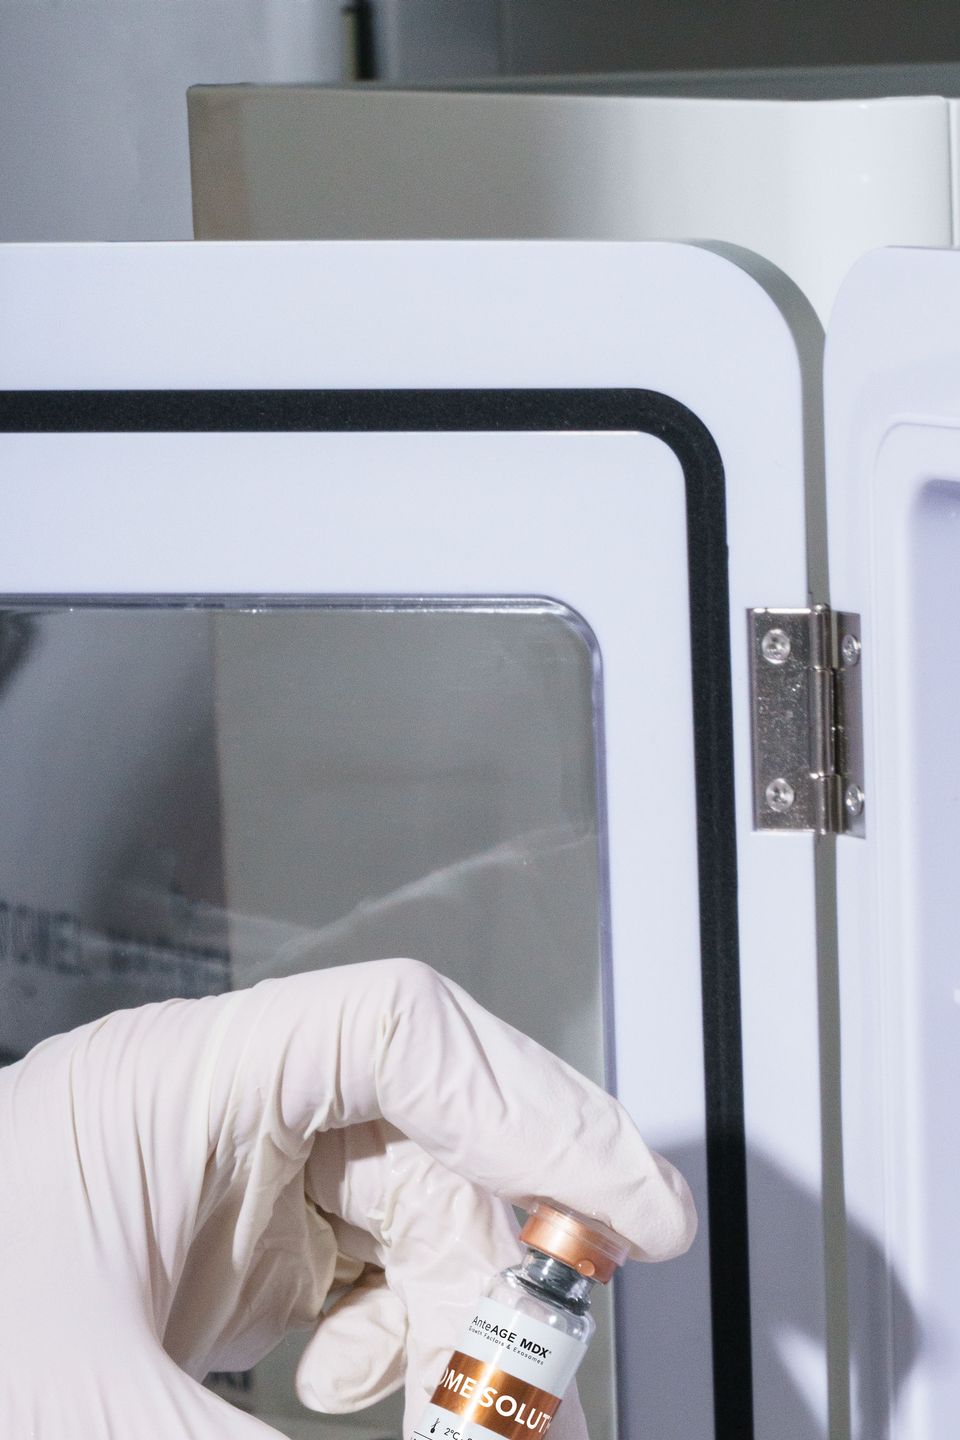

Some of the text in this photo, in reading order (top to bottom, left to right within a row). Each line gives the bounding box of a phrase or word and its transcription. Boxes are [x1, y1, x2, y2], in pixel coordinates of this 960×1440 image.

[471, 1315, 517, 1343] AnteAGE
[483, 1331, 504, 1347] Factors
[512, 1346, 544, 1366] Exosomes
